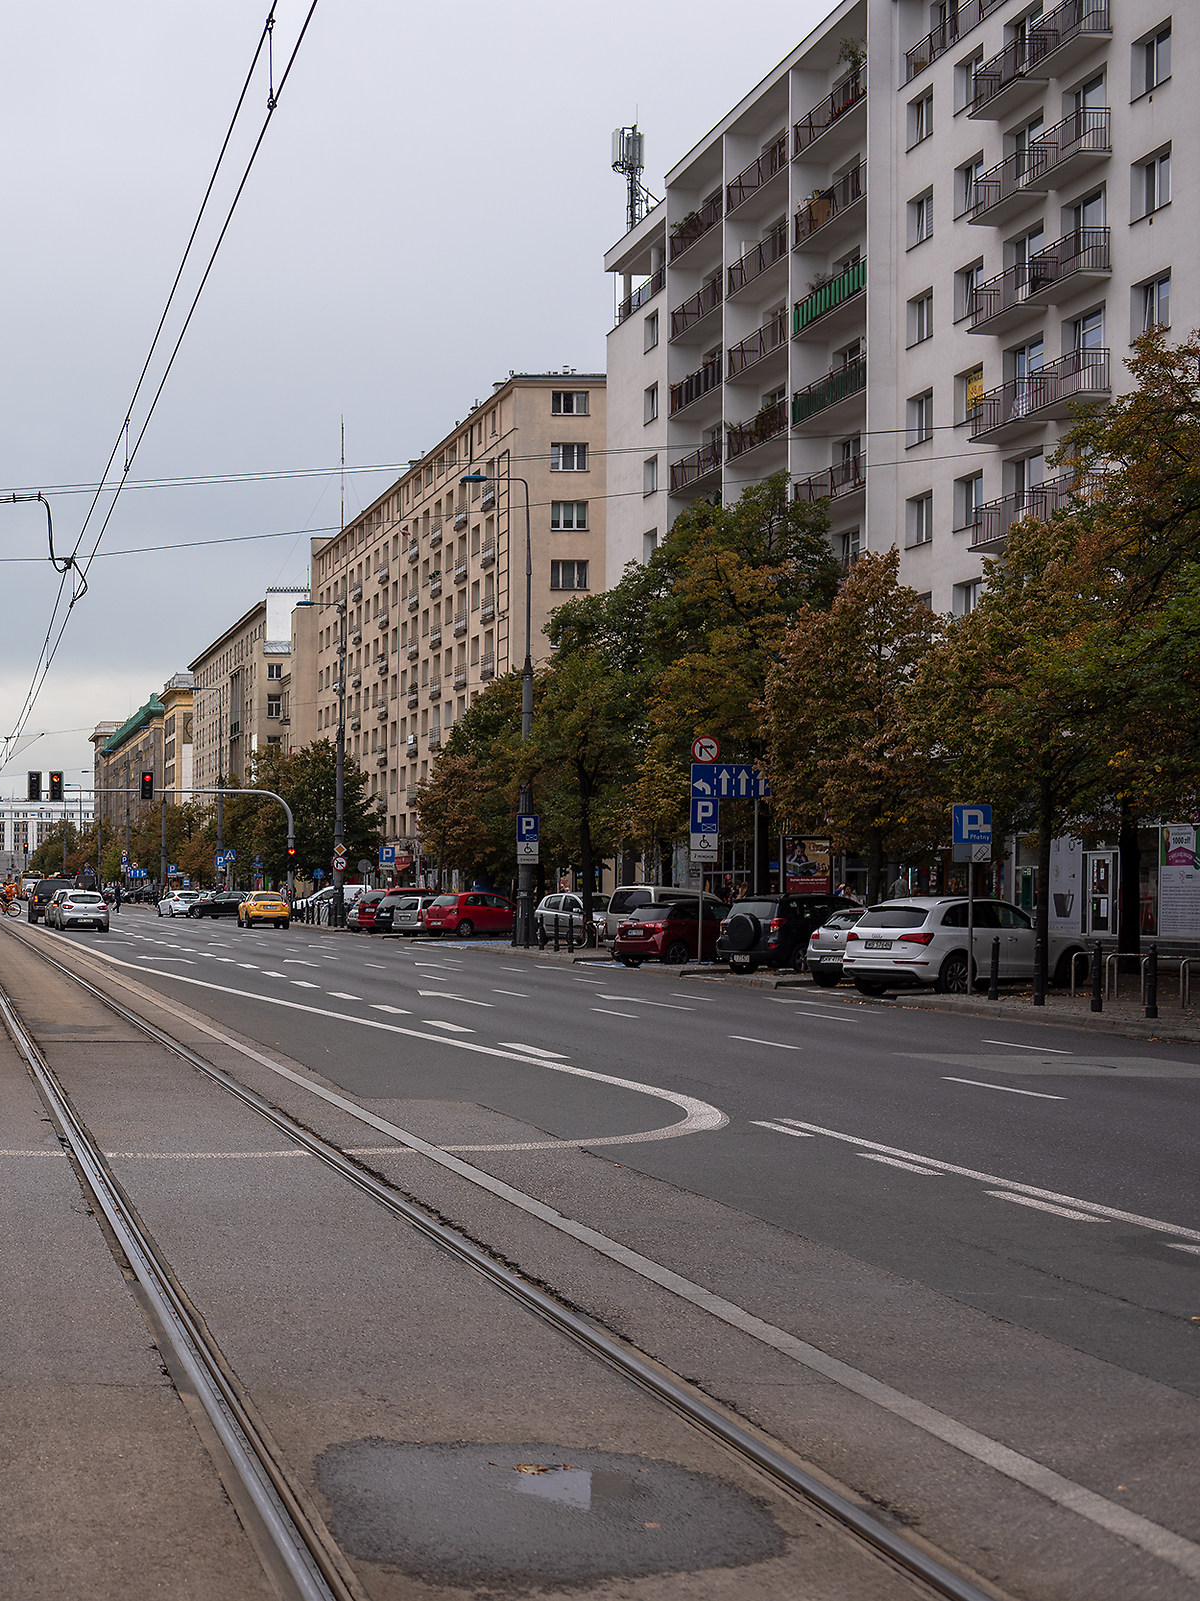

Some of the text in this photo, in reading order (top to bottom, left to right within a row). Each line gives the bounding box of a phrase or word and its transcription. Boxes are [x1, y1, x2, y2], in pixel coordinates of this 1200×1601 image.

[697, 801, 714, 823] P
[522, 817, 535, 834] P
[383, 848, 392, 860] P
